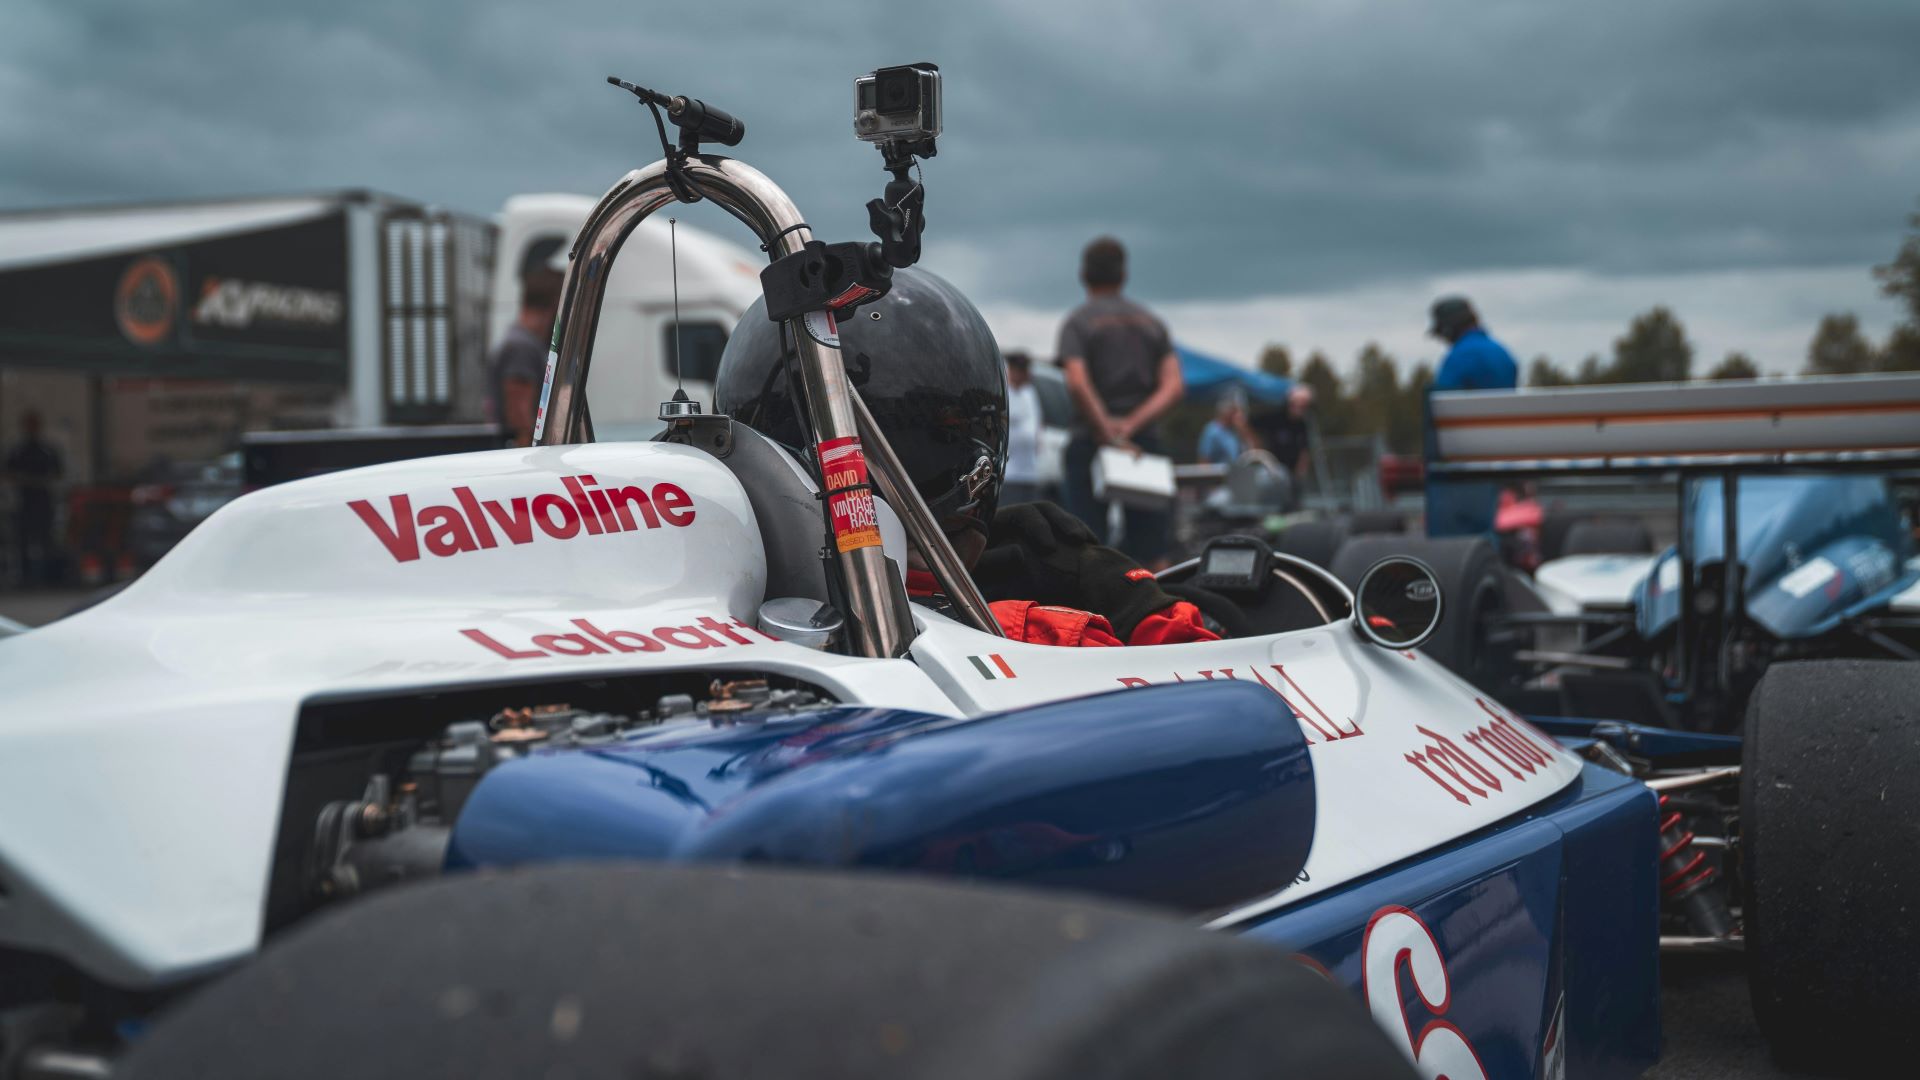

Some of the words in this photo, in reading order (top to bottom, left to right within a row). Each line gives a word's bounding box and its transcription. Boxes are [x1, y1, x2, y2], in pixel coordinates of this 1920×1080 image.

[827, 469, 858, 490] DAVID
[833, 496, 875, 518] VINTAGE
[347, 474, 696, 563] Valvoline
[850, 510, 877, 529] RACE
[1403, 724, 1503, 806] red
